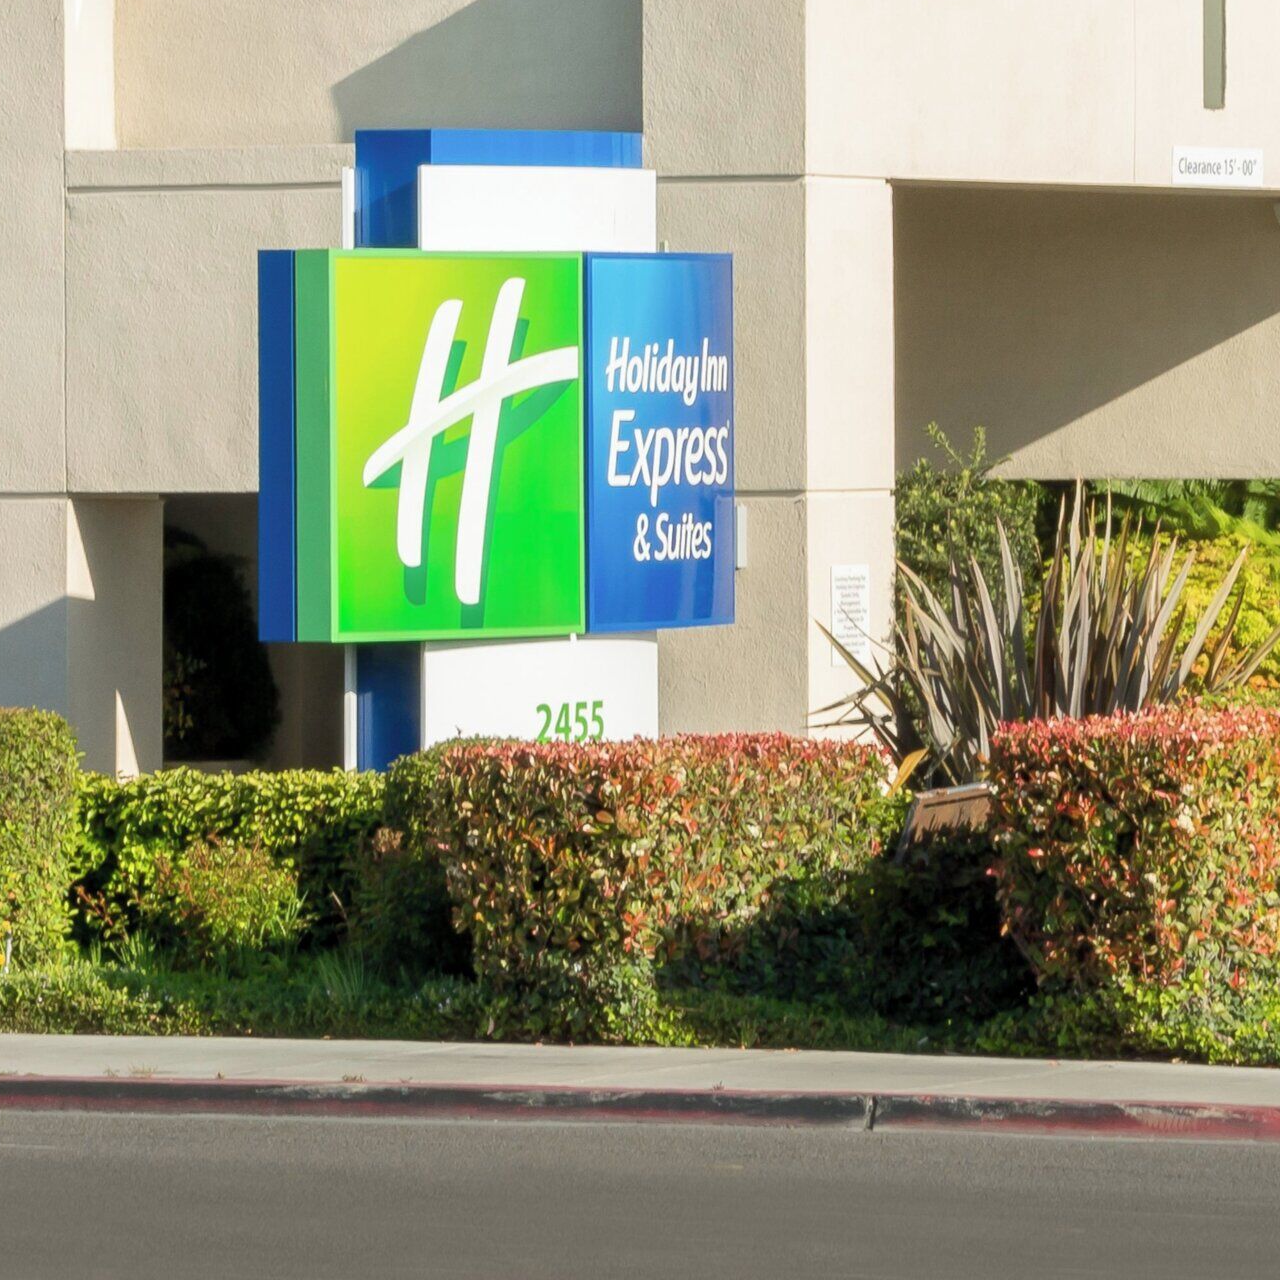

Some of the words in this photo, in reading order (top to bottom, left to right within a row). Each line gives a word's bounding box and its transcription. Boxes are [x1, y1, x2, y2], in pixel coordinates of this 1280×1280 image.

[1178, 156, 1222, 175] Clearance
[605, 336, 699, 406] Holiday
[701, 337, 728, 392] Inn
[607, 409, 728, 507] Express
[633, 512, 651, 562] &
[654, 512, 712, 560] Suites
[536, 700, 604, 745] 2455
